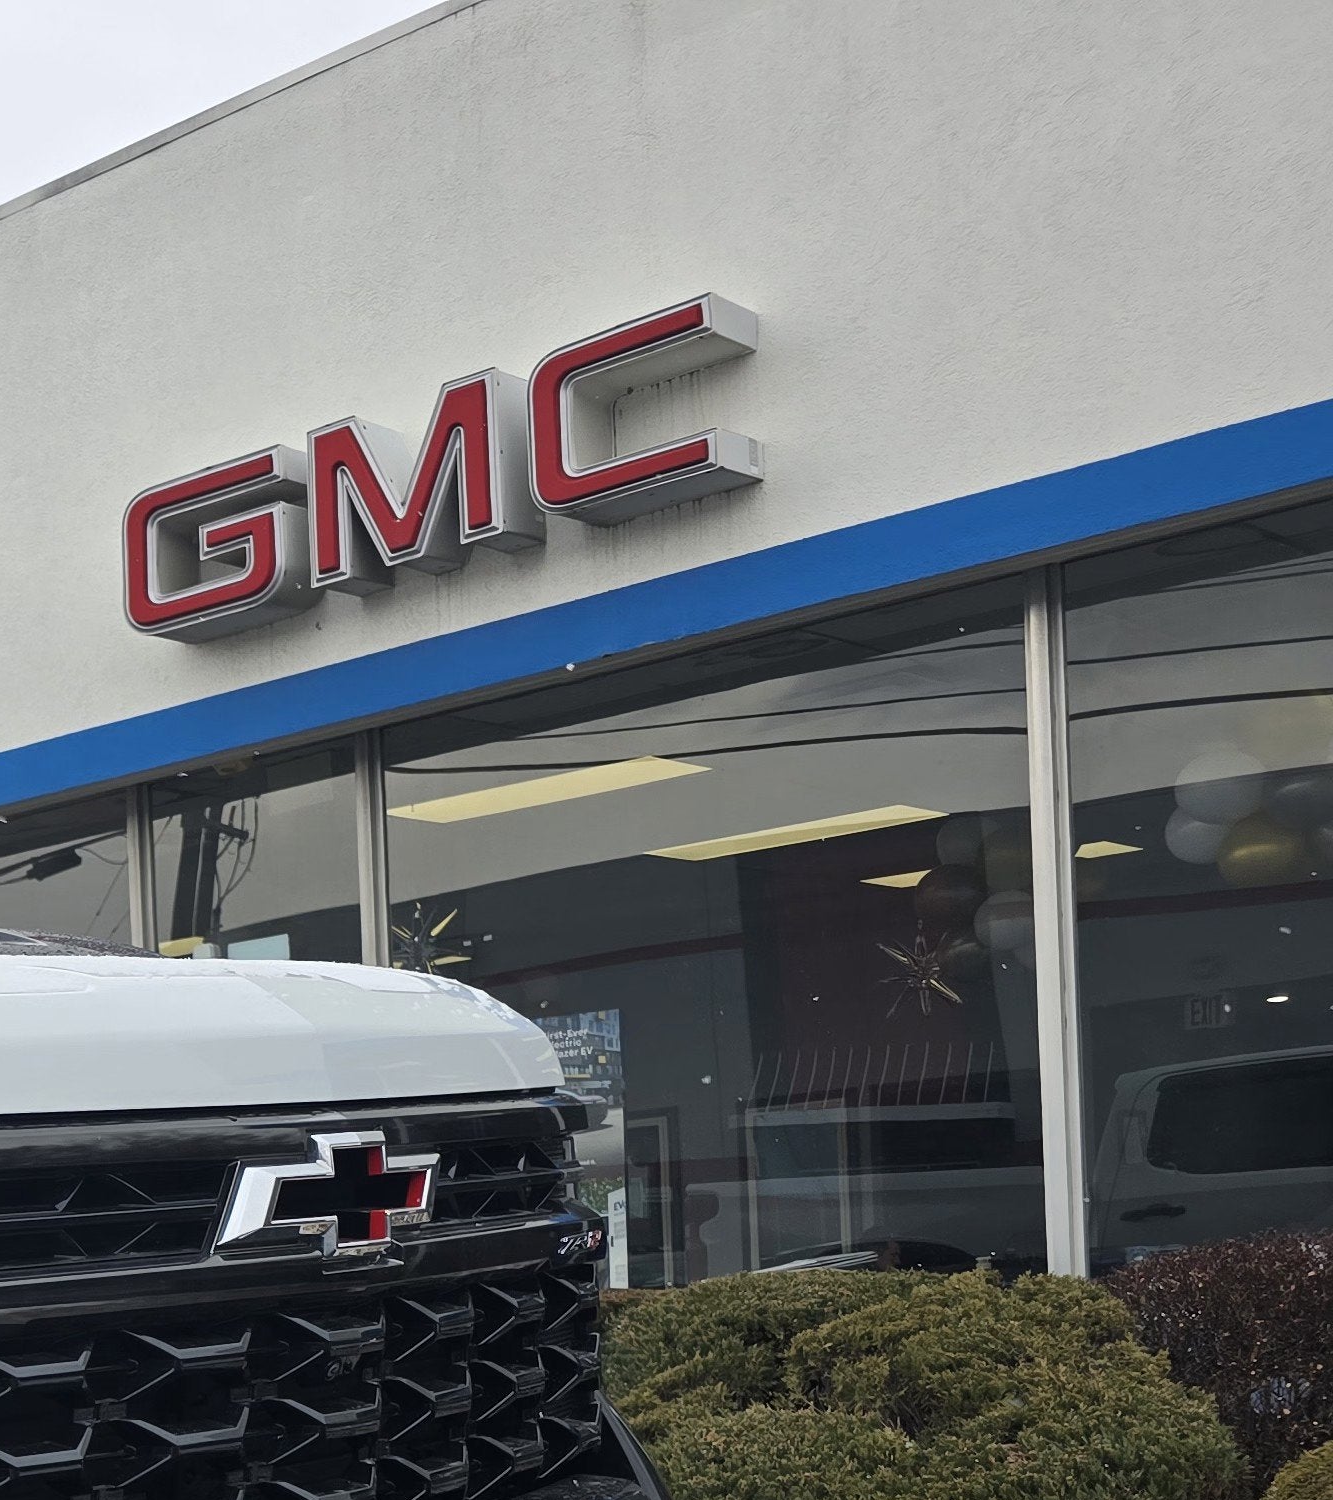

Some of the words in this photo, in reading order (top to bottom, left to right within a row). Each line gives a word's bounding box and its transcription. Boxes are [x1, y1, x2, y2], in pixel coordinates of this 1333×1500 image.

[123, 292, 763, 643] GMC
[1190, 996, 1222, 1025] EXIT
[546, 1028, 588, 1040] irst-Ever
[580, 1046, 593, 1056] EV
[557, 1229, 602, 1255] ZR2
